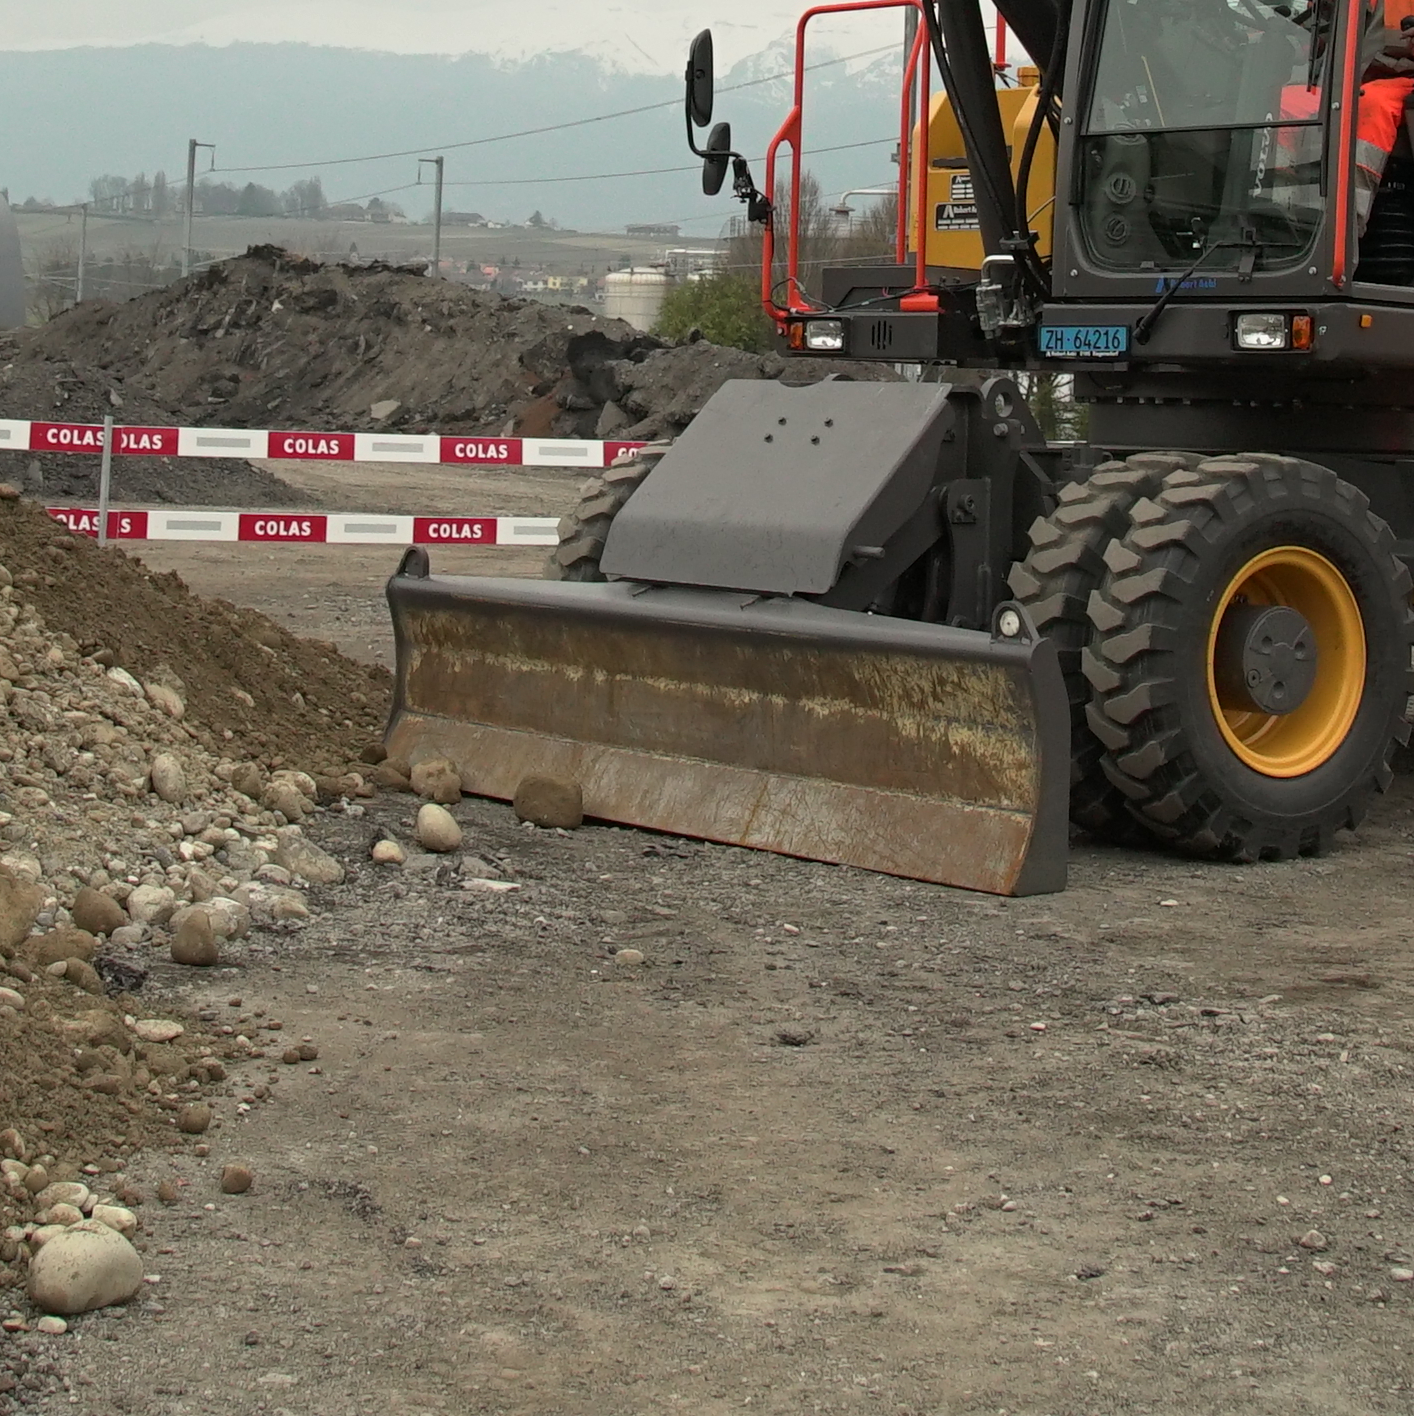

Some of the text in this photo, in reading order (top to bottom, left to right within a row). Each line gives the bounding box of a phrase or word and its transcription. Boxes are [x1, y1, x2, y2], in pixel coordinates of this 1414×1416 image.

[1253, 112, 1274, 198] VOLVO
[47, 428, 105, 446] COLAS
[283, 438, 340, 455] COLAS
[454, 443, 508, 460] COLAS
[254, 520, 312, 537] COLAS
[428, 523, 483, 540] COLAS
